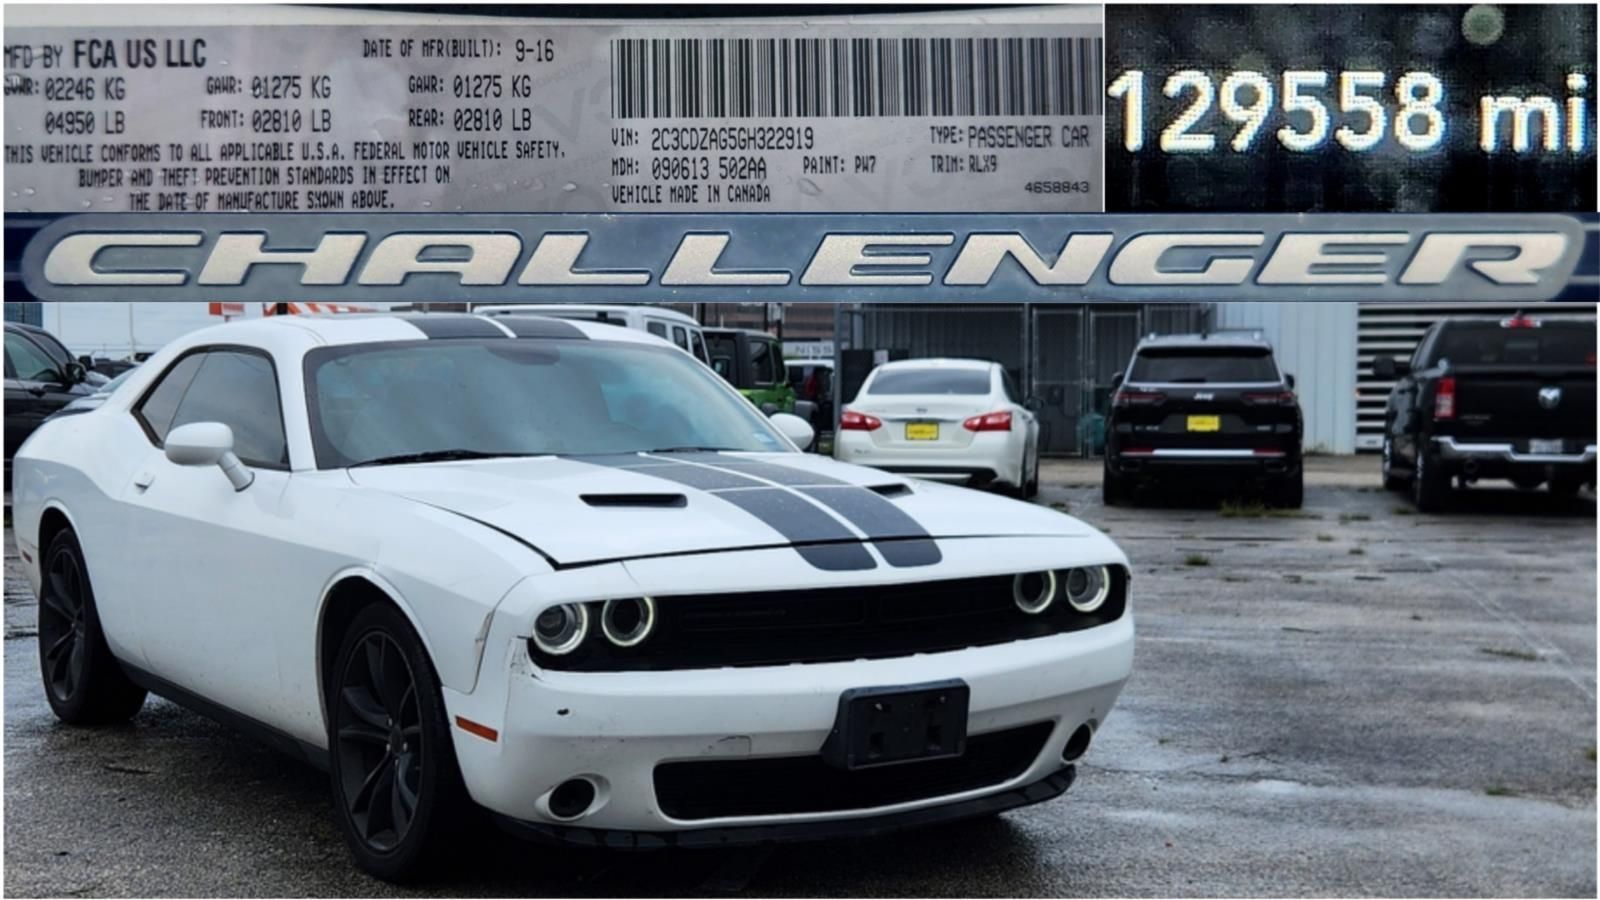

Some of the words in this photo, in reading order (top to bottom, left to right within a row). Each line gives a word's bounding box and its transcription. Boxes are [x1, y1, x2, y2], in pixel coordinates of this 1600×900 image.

[43, 45, 63, 69] BY
[73, 39, 118, 69] FCA
[126, 39, 157, 69] US
[165, 39, 207, 69] LLC
[363, 39, 393, 58] DATE
[400, 39, 414, 58] OF
[422, 39, 502, 58] MFR(BUILT):
[515, 39, 555, 62] 9-16
[45, 77, 96, 101] 02246
[104, 77, 126, 101] KG
[206, 76, 243, 96] GAWR:
[252, 76, 302, 99] 01275
[311, 76, 332, 99] KG
[408, 75, 445, 94] GAWR:
[453, 75, 503, 98] 01275
[511, 75, 532, 98] KG
[45, 110, 96, 135] 04950
[104, 110, 126, 135] LB
[201, 110, 245, 129] FRONT:
[252, 109, 302, 133] 02810
[311, 109, 332, 132] LB
[408, 108, 445, 127] REAR:
[453, 108, 503, 132] 02810
[511, 108, 532, 131] LB
[1107, 70, 1447, 153] 129558
[1479, 72, 1590, 153] mi
[611, 128, 640, 146] VIN:
[651, 127, 815, 151] 2C3CDZAG5GH322919
[929, 125, 964, 144] TYPE:
[967, 125, 1053, 149] PASSENGER
[1060, 124, 1091, 148] CAR
[4, 145, 34, 164] THIS
[41, 144, 94, 164] VEHICLE
[100, 144, 161, 163] CONFORMS
[169, 144, 184, 162] TO
[190, 144, 213, 162] ALL
[220, 143, 295, 162] APPLICABLE
[301, 142, 346, 161] U.S.A.
[353, 142, 406, 160] FEDERAL
[413, 142, 450, 160] MOTOR
[457, 141, 509, 160] VEHICLE
[930, 155, 964, 173] TRIM:
[968, 154, 998, 173] RLX9
[611, 157, 640, 176] MDH:
[651, 157, 710, 180] 090613
[718, 156, 768, 180] 502AA
[802, 155, 846, 174] PAINT:
[854, 155, 877, 174] PW7
[78, 169, 124, 188] BUMPER
[131, 169, 154, 188] AND
[162, 168, 199, 188] THEFT
[205, 168, 281, 186] PREVENTION
[287, 167, 355, 186] STANDARDS
[362, 166, 377, 185] IN
[383, 166, 428, 185] EFFECT
[435, 166, 451, 184] ON
[1024, 181, 1091, 194] 4658843
[129, 192, 151, 211] THE
[158, 192, 190, 211] DATE
[195, 192, 210, 211] OF
[217, 191, 300, 210] MANUFACTURE
[352, 190, 396, 208] ABOVE.
[611, 185, 663, 204] VEHICLE
[669, 185, 699, 203] MADE
[706, 185, 721, 203] IN
[727, 184, 772, 203] CANADA
[42, 231, 1570, 287] CHALLENGER
